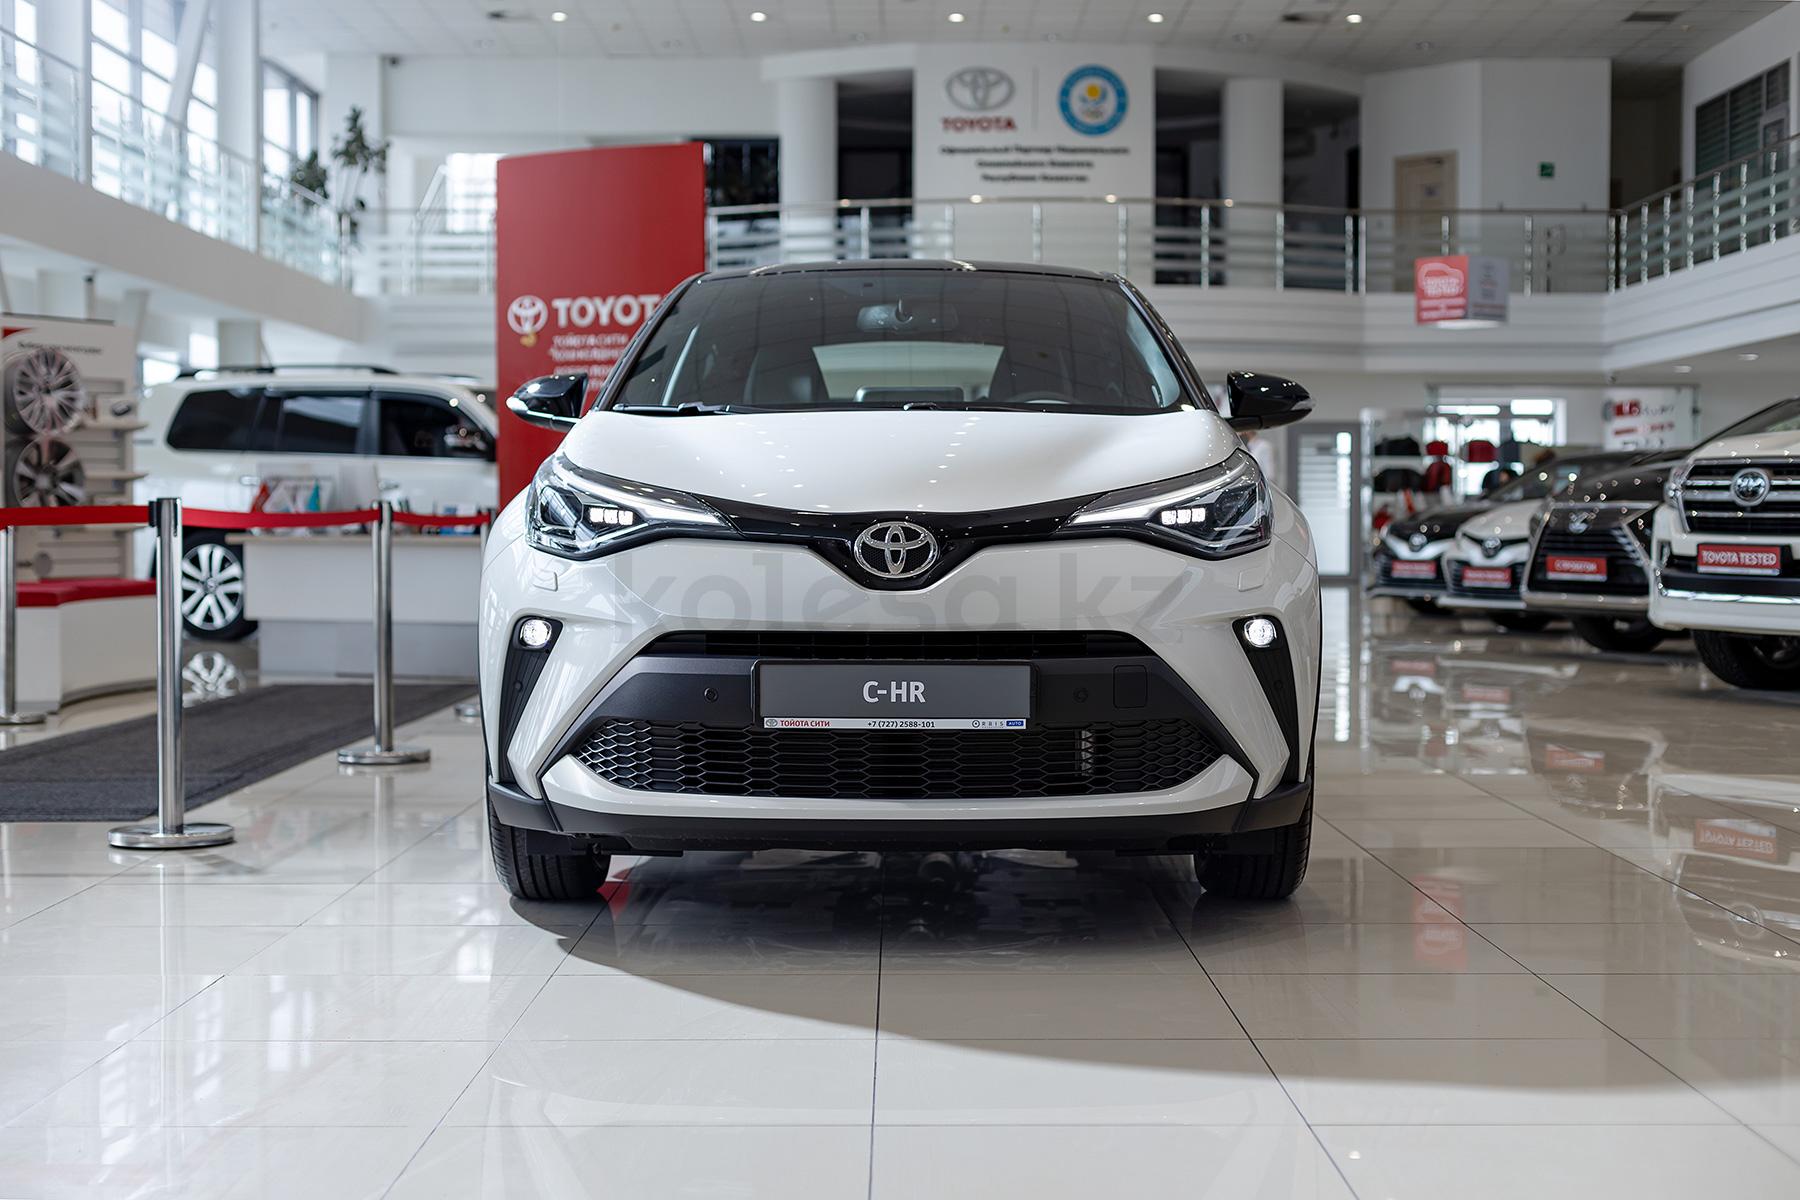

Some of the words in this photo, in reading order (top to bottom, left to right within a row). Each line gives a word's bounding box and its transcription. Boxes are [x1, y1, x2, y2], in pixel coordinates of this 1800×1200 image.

[941, 116, 1016, 132] TOYOTA
[552, 295, 665, 328] TOYOT
[1702, 550, 1739, 565] TOYOTA
[1739, 551, 1777, 566] TESTED
[862, 680, 926, 703] C-HR
[780, 719, 809, 727] ТОЙОТА
[868, 720, 876, 728] +7
[878, 719, 898, 728] (727)
[899, 720, 935, 728] 2588-101
